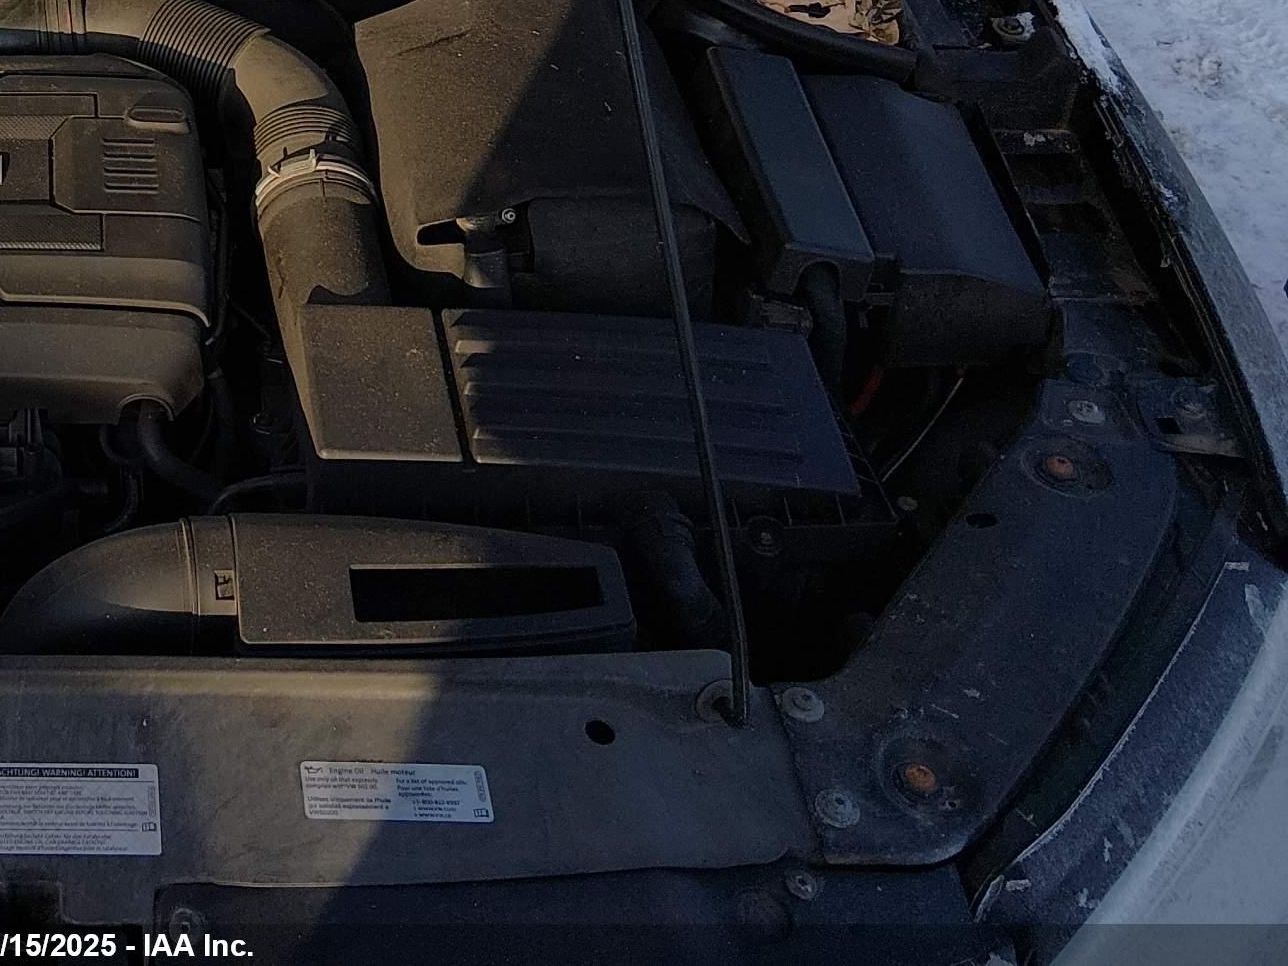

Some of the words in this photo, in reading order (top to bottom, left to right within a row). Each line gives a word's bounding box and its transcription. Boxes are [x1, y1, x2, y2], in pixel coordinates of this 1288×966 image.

[41, 768, 86, 777] WARNING!
[87, 768, 136, 777] ATTENTION!
[329, 767, 353, 775] Engine
